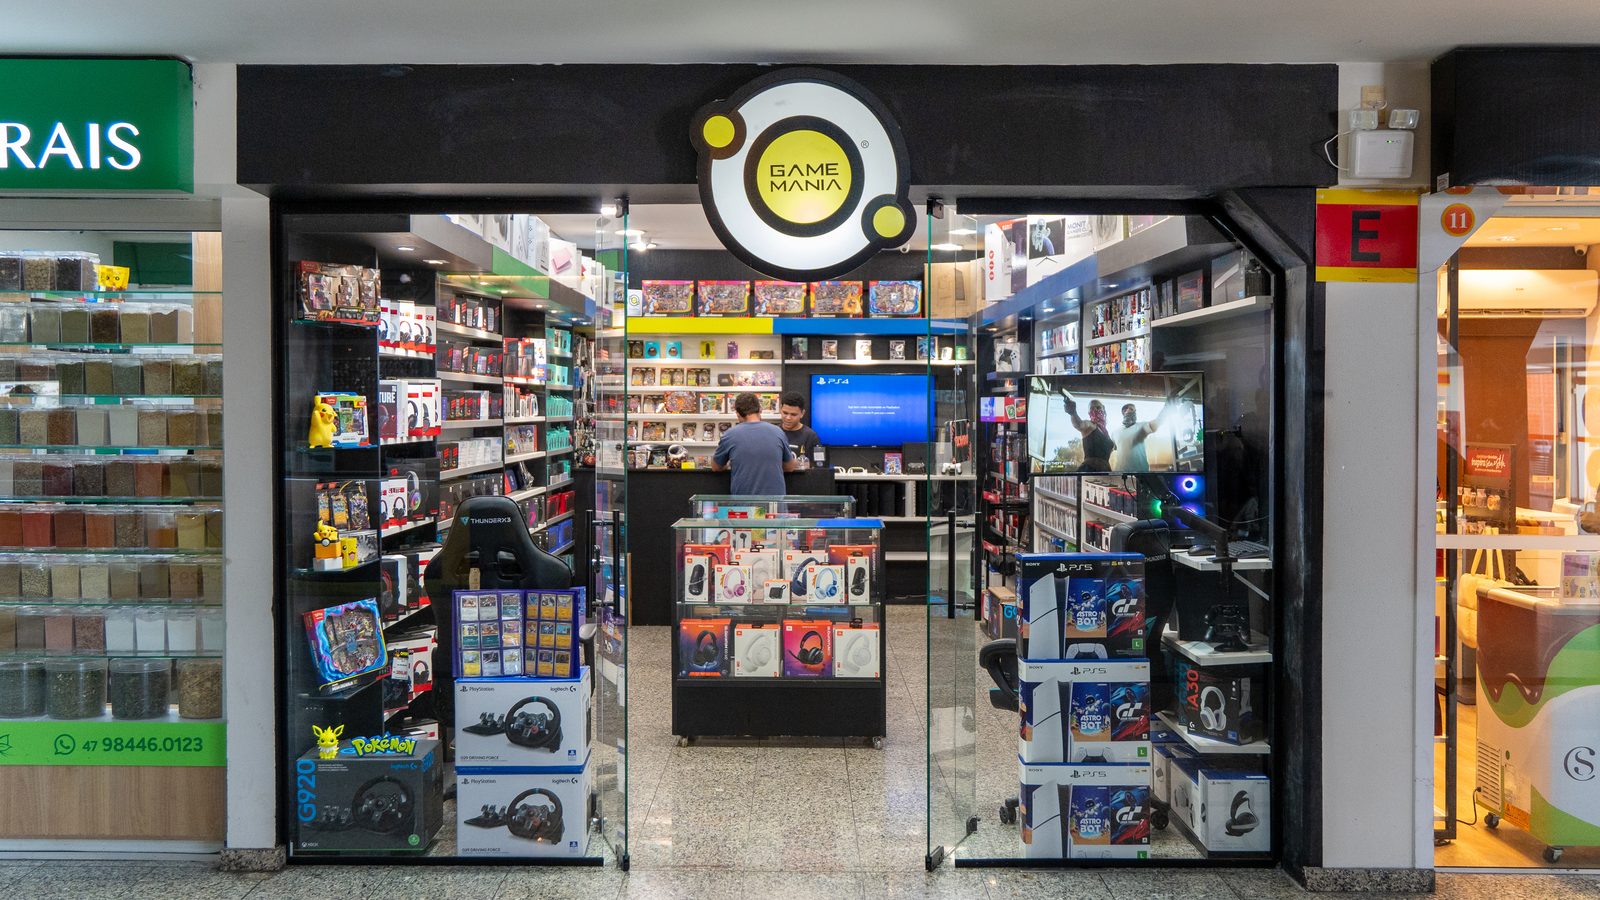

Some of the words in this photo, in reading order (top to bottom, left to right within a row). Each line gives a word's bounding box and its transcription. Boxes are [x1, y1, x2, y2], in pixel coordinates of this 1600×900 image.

[0, 121, 141, 169] RAIS
[770, 163, 839, 177] GAME
[770, 178, 842, 192] MANIA
[1450, 212, 1467, 229] 11
[1351, 210, 1381, 262] E
[83, 741, 97, 752] 47
[102, 737, 204, 752] 98446.0123
[296, 759, 317, 822] G920
